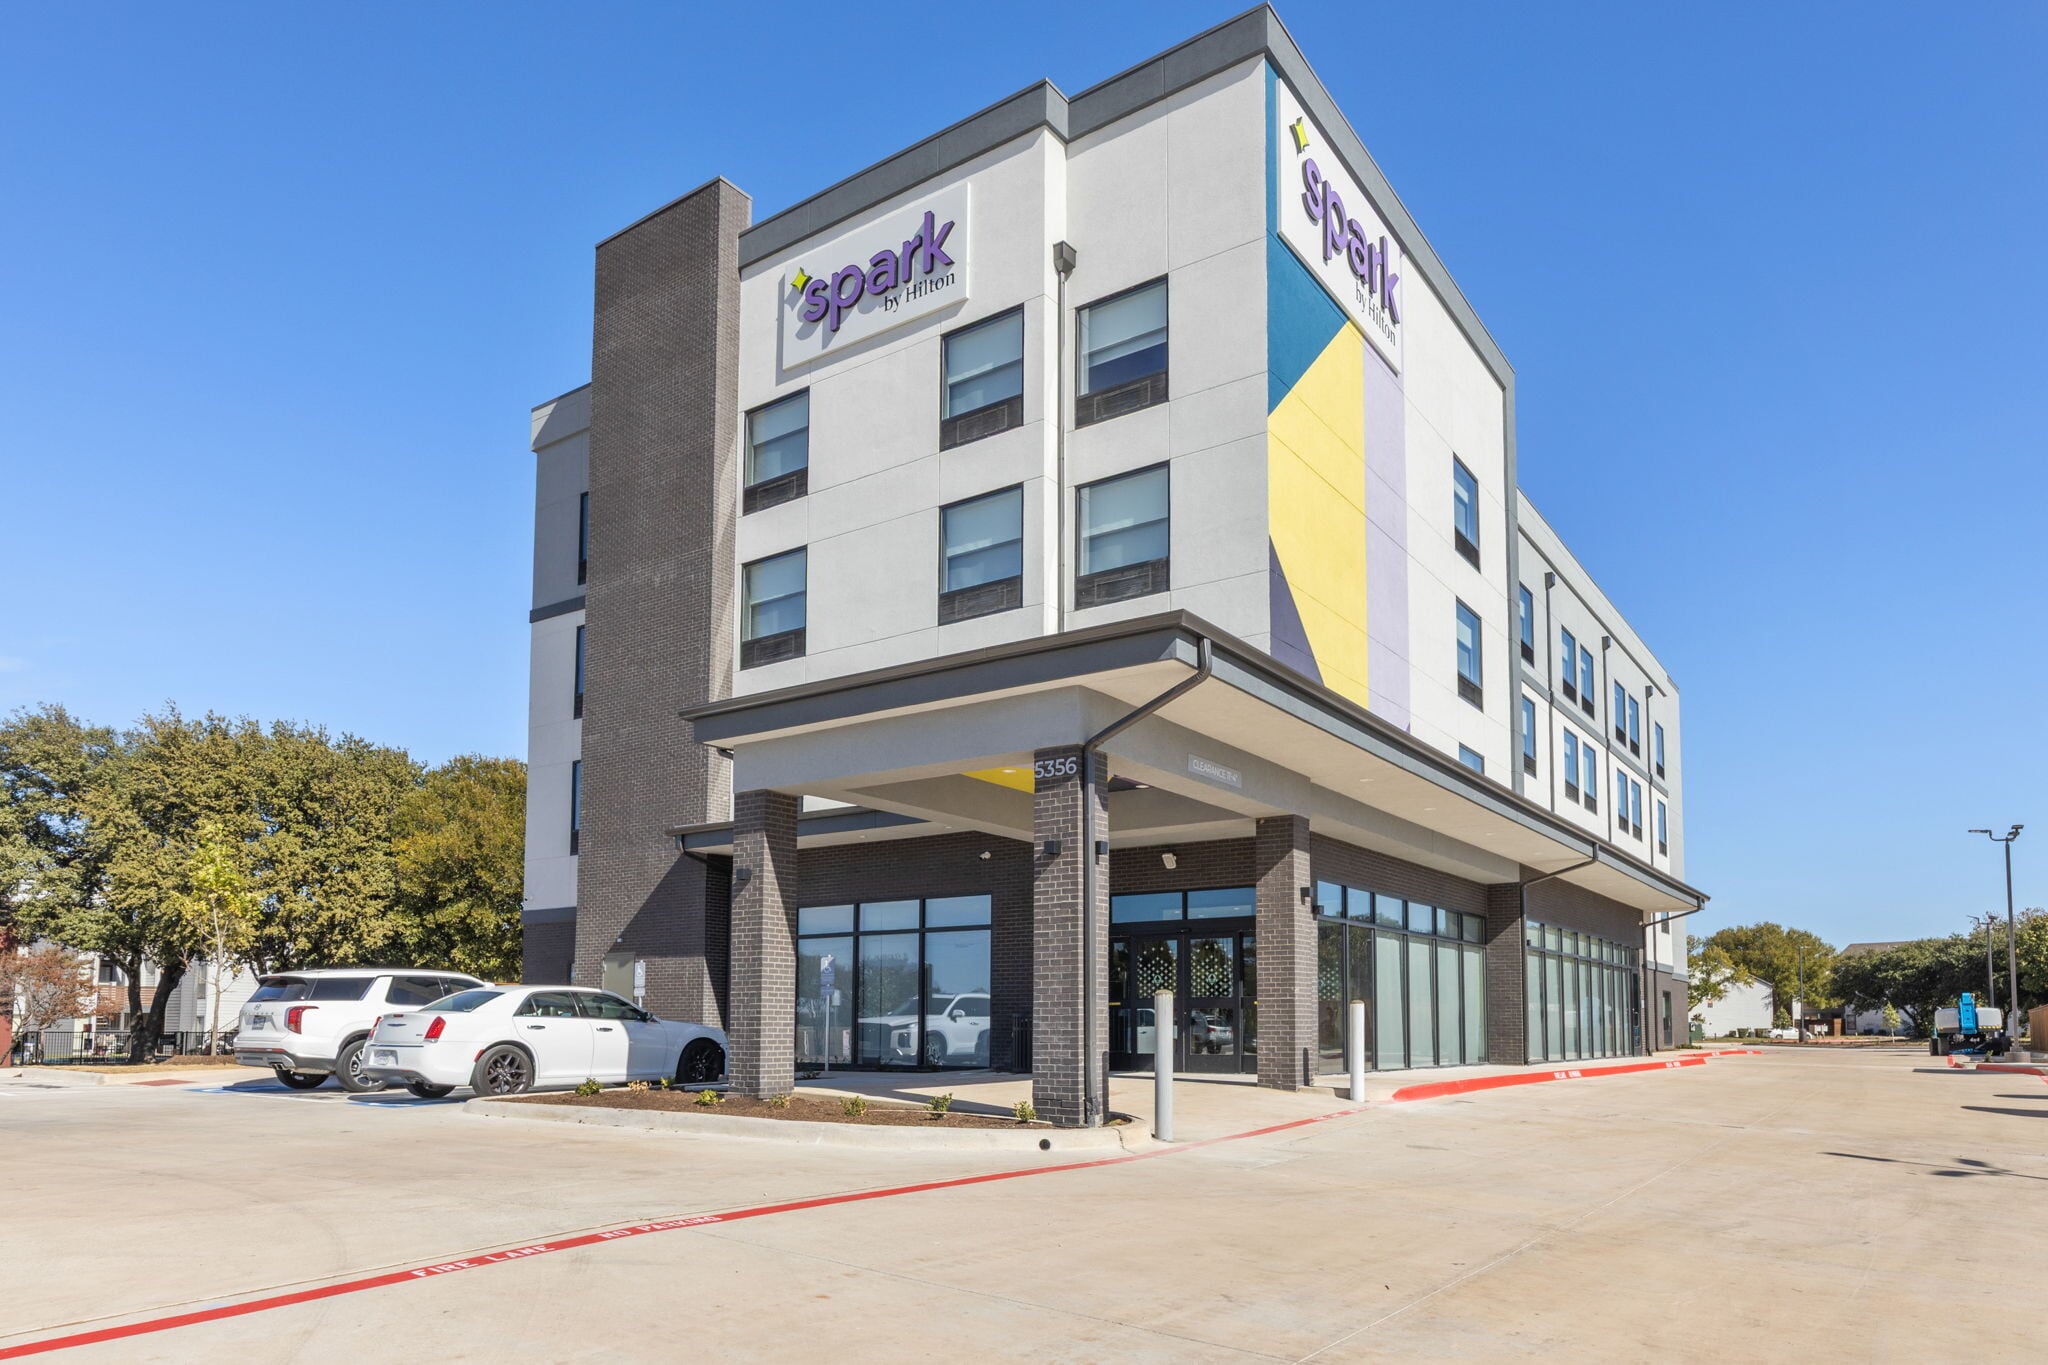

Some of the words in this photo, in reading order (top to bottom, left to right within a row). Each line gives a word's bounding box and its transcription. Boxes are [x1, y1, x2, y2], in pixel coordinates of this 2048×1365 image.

[803, 211, 955, 332] spark
[1302, 158, 1400, 326] spark
[884, 295, 902, 313] by
[906, 271, 955, 303] Hilton
[1355, 281, 1366, 313] by
[1368, 298, 1396, 347] Hilton
[1035, 757, 1077, 779] 5356
[411, 1260, 478, 1277] FIRE
[484, 1245, 555, 1262] LANE
[598, 1230, 632, 1239] NO
[636, 1216, 723, 1231] PARKING
